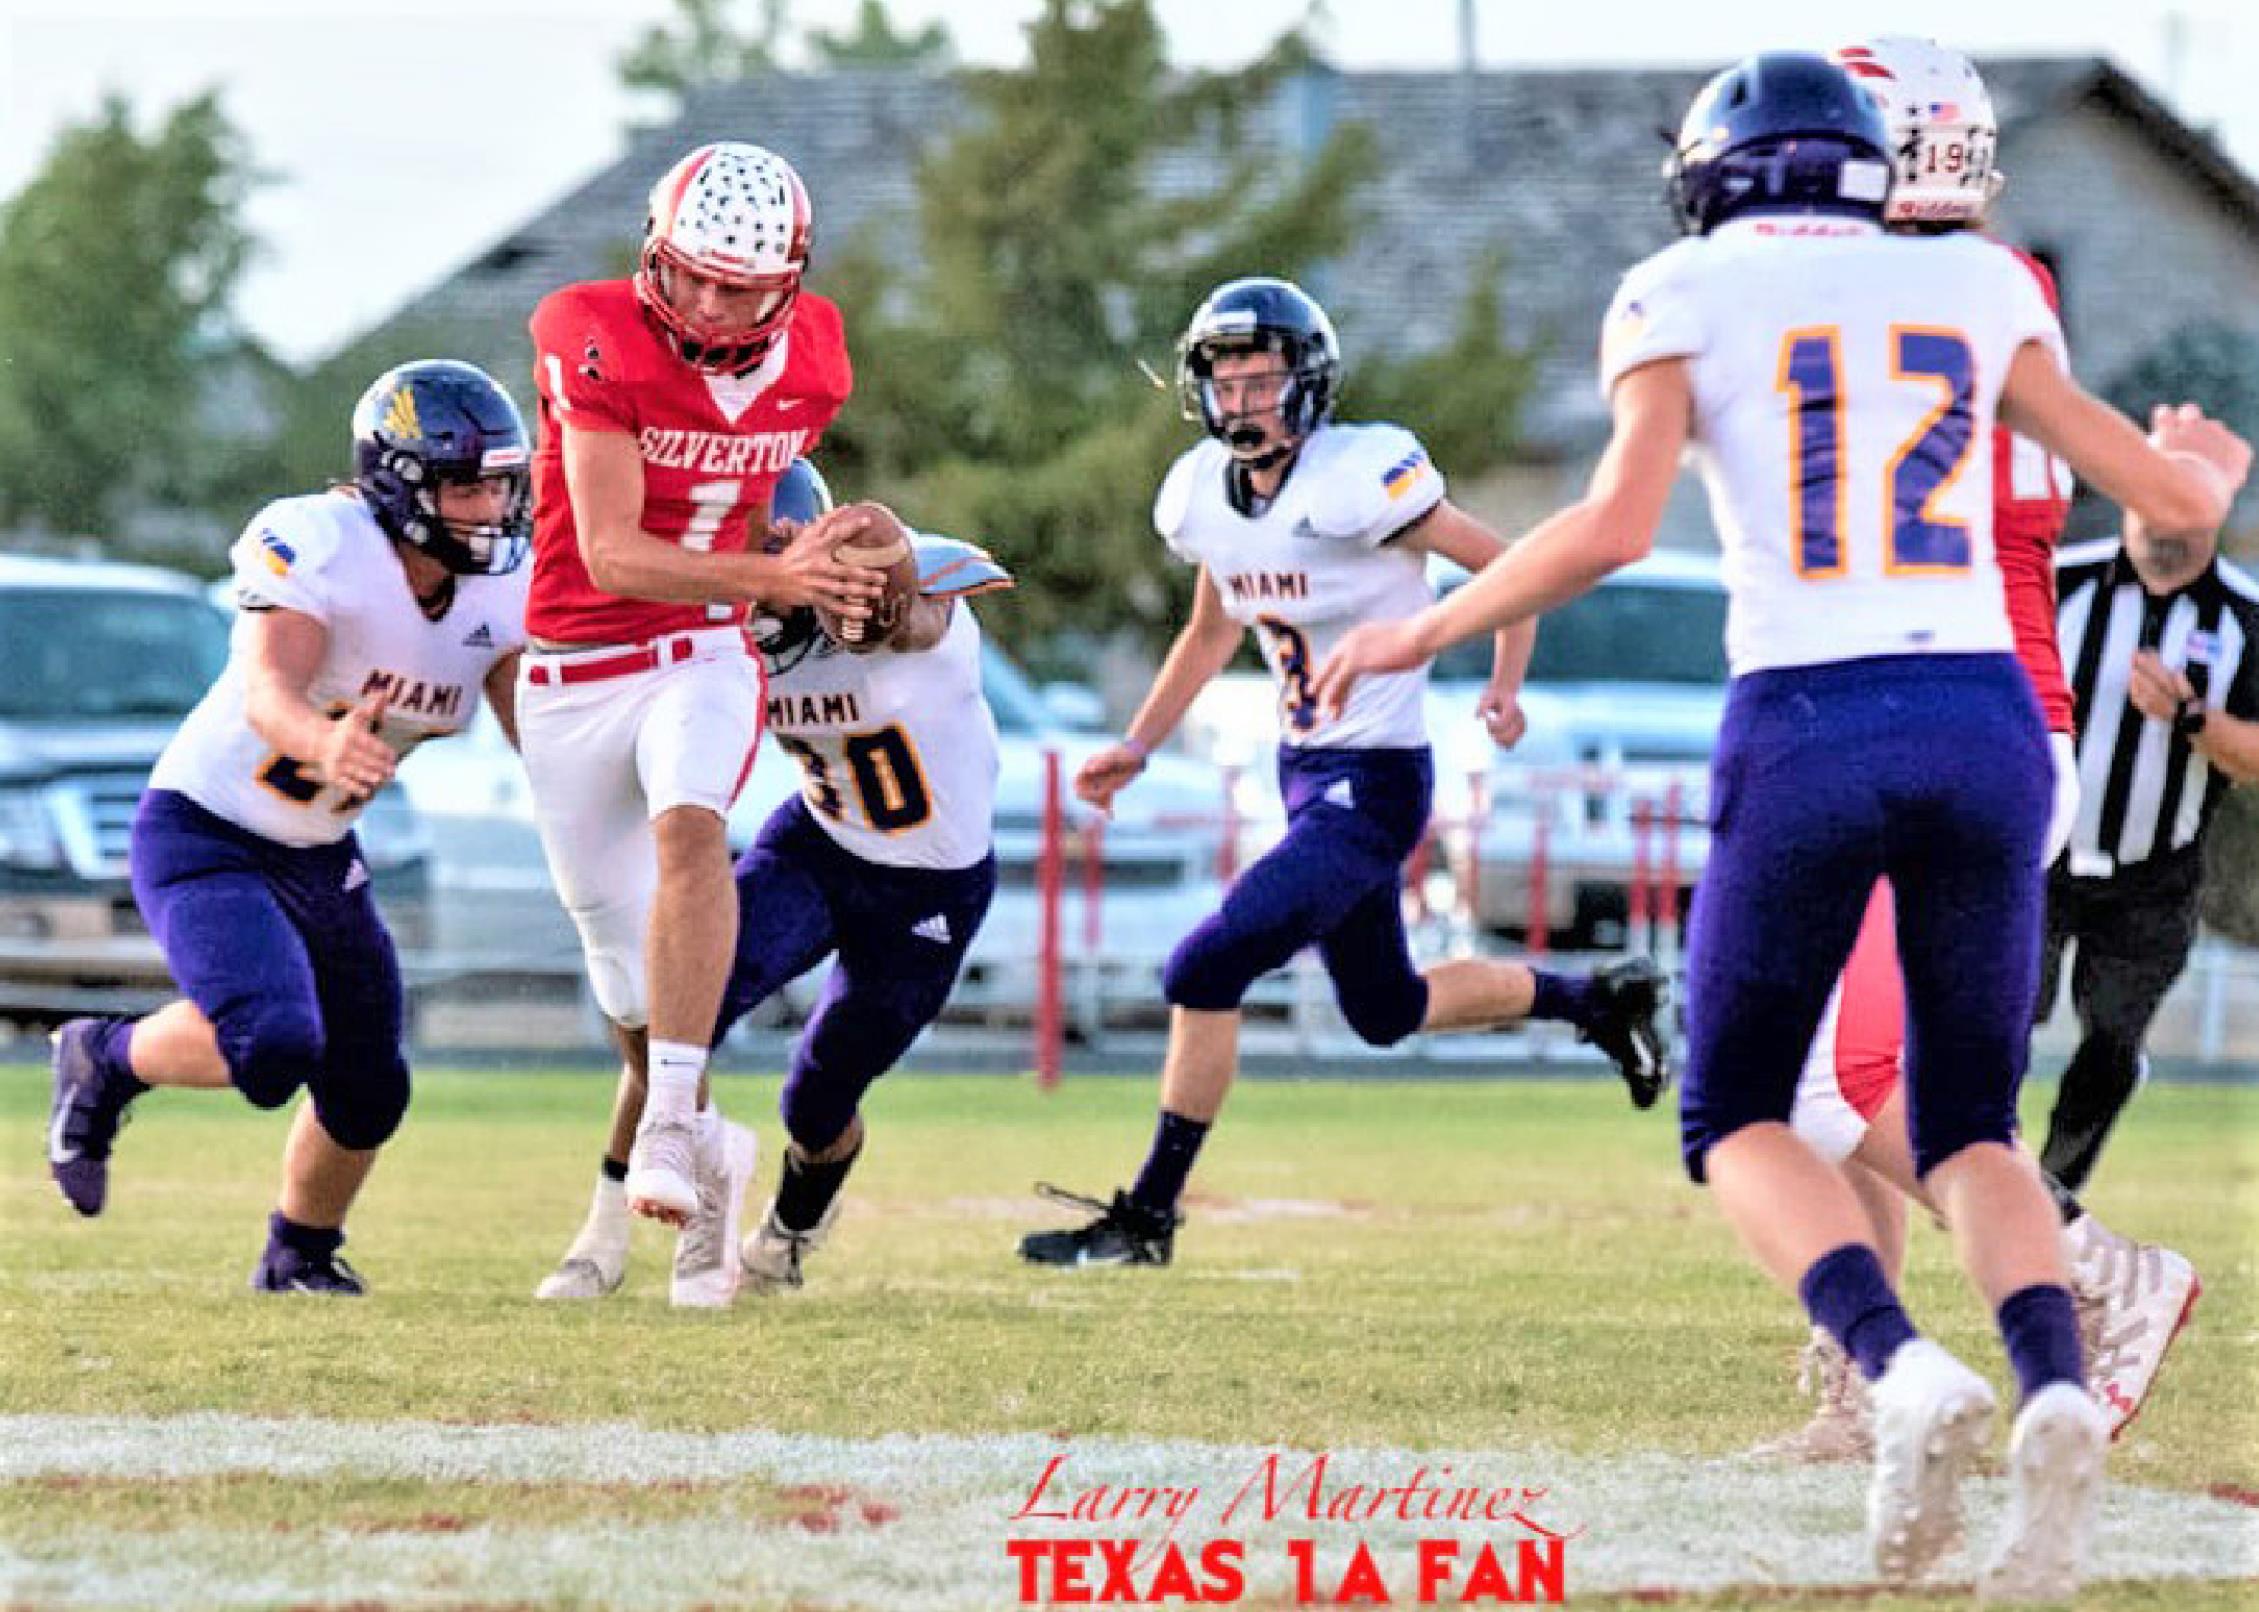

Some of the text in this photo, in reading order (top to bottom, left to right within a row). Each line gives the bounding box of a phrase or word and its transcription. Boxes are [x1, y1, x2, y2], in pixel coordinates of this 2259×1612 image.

[1926, 142, 1964, 174] 19
[640, 427, 808, 475] SILVERTON
[1773, 324, 1976, 580] 12
[1228, 571, 1308, 599] MIAMI
[361, 669, 463, 715] MIAMI
[767, 693, 860, 726] MIAMI
